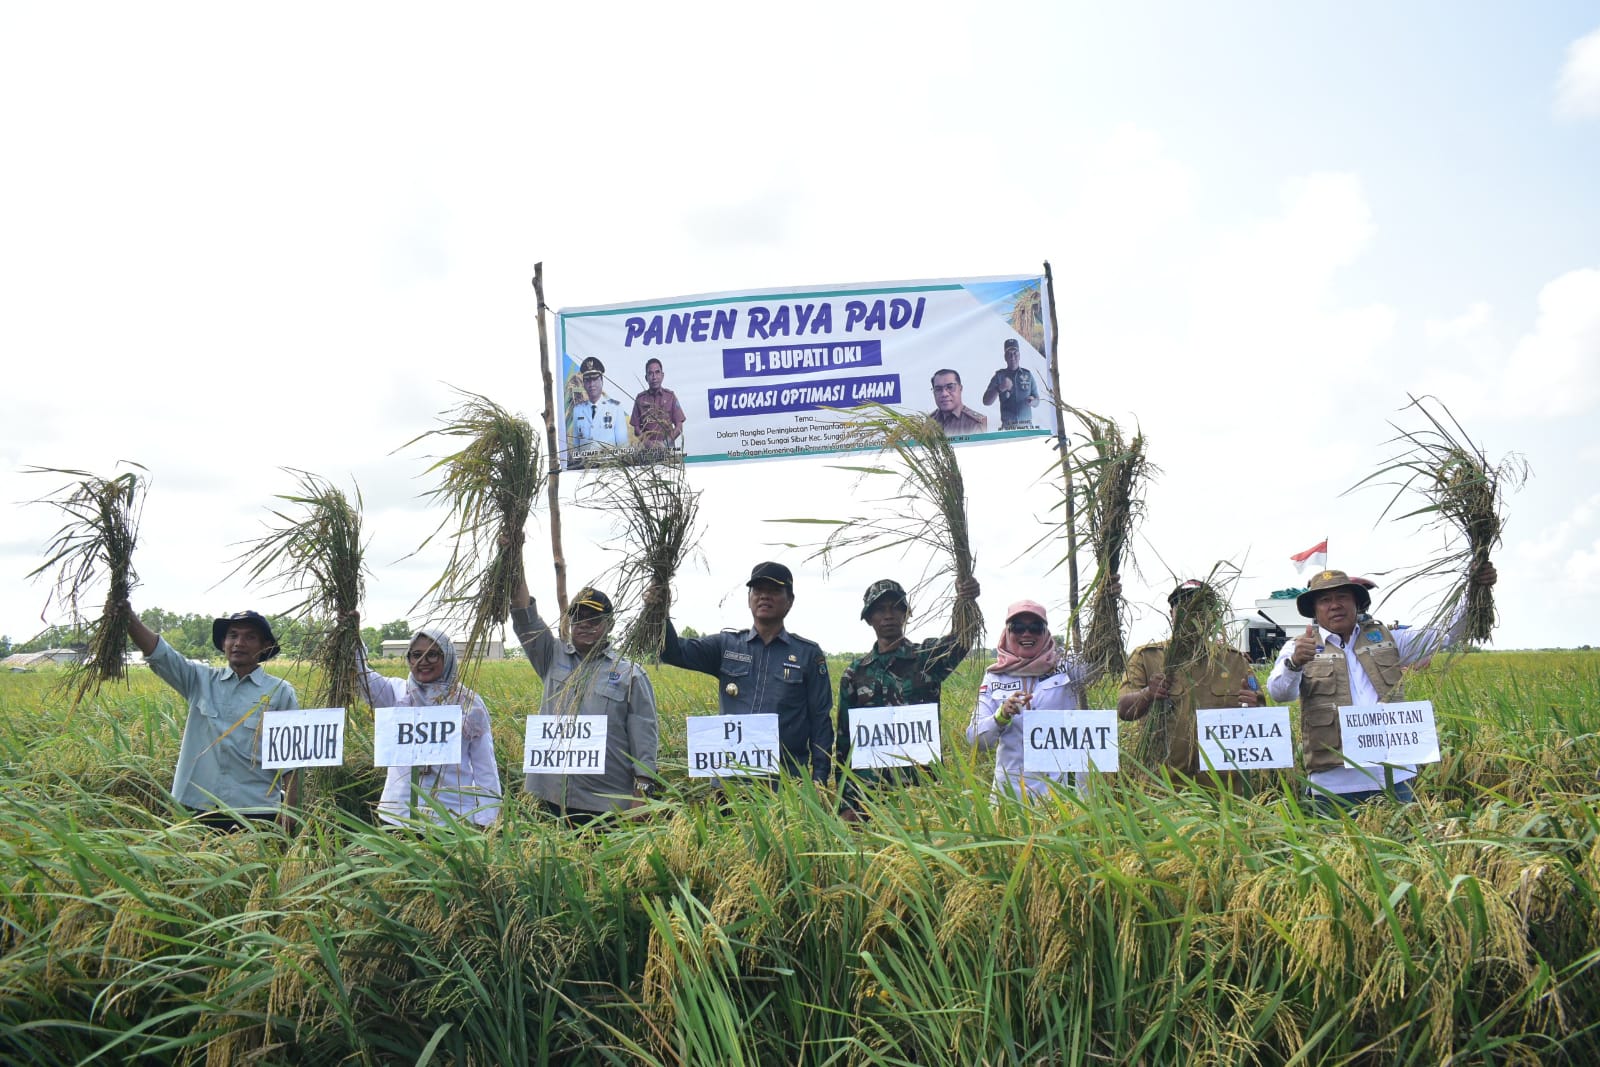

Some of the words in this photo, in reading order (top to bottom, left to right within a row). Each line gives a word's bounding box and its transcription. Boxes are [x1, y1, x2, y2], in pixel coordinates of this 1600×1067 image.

[624, 308, 738, 347] PANEN
[747, 302, 833, 340] RAYA
[845, 297, 926, 332] PADI
[744, 353, 766, 372] Pj.
[769, 348, 829, 369] BUPATI
[832, 345, 862, 365] OKI
[713, 394, 729, 410] DI
[732, 390, 778, 409] LOKASI
[781, 385, 845, 407] OPTIMASI
[852, 381, 895, 400] LAHAN
[740, 428, 765, 438] Rangka
[767, 425, 808, 435] Peningkatan
[768, 437, 790, 445] Sungai
[791, 435, 807, 443] Sibur
[1346, 712, 1396, 728] KELOMPOK
[1398, 710, 1424, 726] TANI
[397, 721, 456, 745] BSIP
[542, 722, 592, 740] KADIS
[724, 722, 742, 744] Pj
[857, 720, 933, 747] DANDIM
[1030, 726, 1110, 750] CAMAT
[1205, 723, 1283, 740] KEPALA
[1358, 735, 1386, 749] SIBUR
[1386, 733, 1410, 750] JAYA
[1412, 732, 1420, 746] 8
[268, 724, 338, 762] KORLUH
[530, 749, 600, 768] DKPTPH
[695, 749, 774, 770] BUPATI
[1223, 747, 1274, 763] DESA
